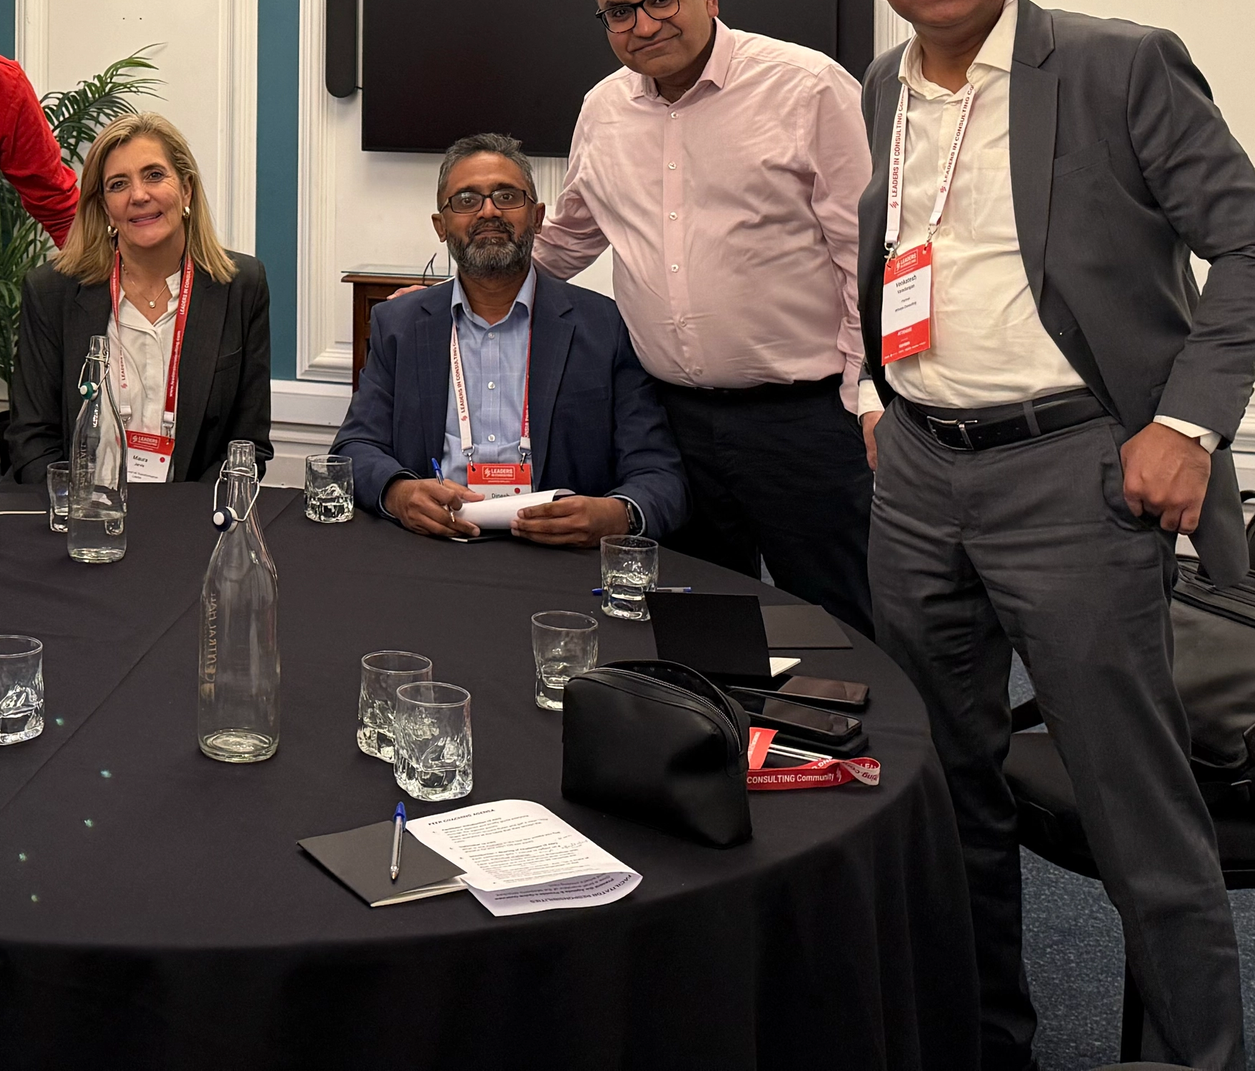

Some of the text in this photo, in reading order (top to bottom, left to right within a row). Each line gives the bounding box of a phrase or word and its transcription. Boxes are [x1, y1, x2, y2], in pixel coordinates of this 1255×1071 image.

[894, 113, 903, 156] CONSULTING
[943, 151, 954, 183] LEADERS
[952, 142, 958, 152] IN
[955, 97, 970, 141] CONSULTING
[893, 157, 900, 166] IN
[891, 167, 899, 198] LEADERS
[900, 252, 917, 265] LEADERS
[179, 294, 188, 315] LEADERS
[453, 347, 466, 414] LEADERS IN CONSULTING
[138, 436, 158, 444] LEADERS
[746, 773, 796, 784] CONSULTING
[796, 772, 835, 782] Community
[592, 874, 633, 897] FACILITATOR
